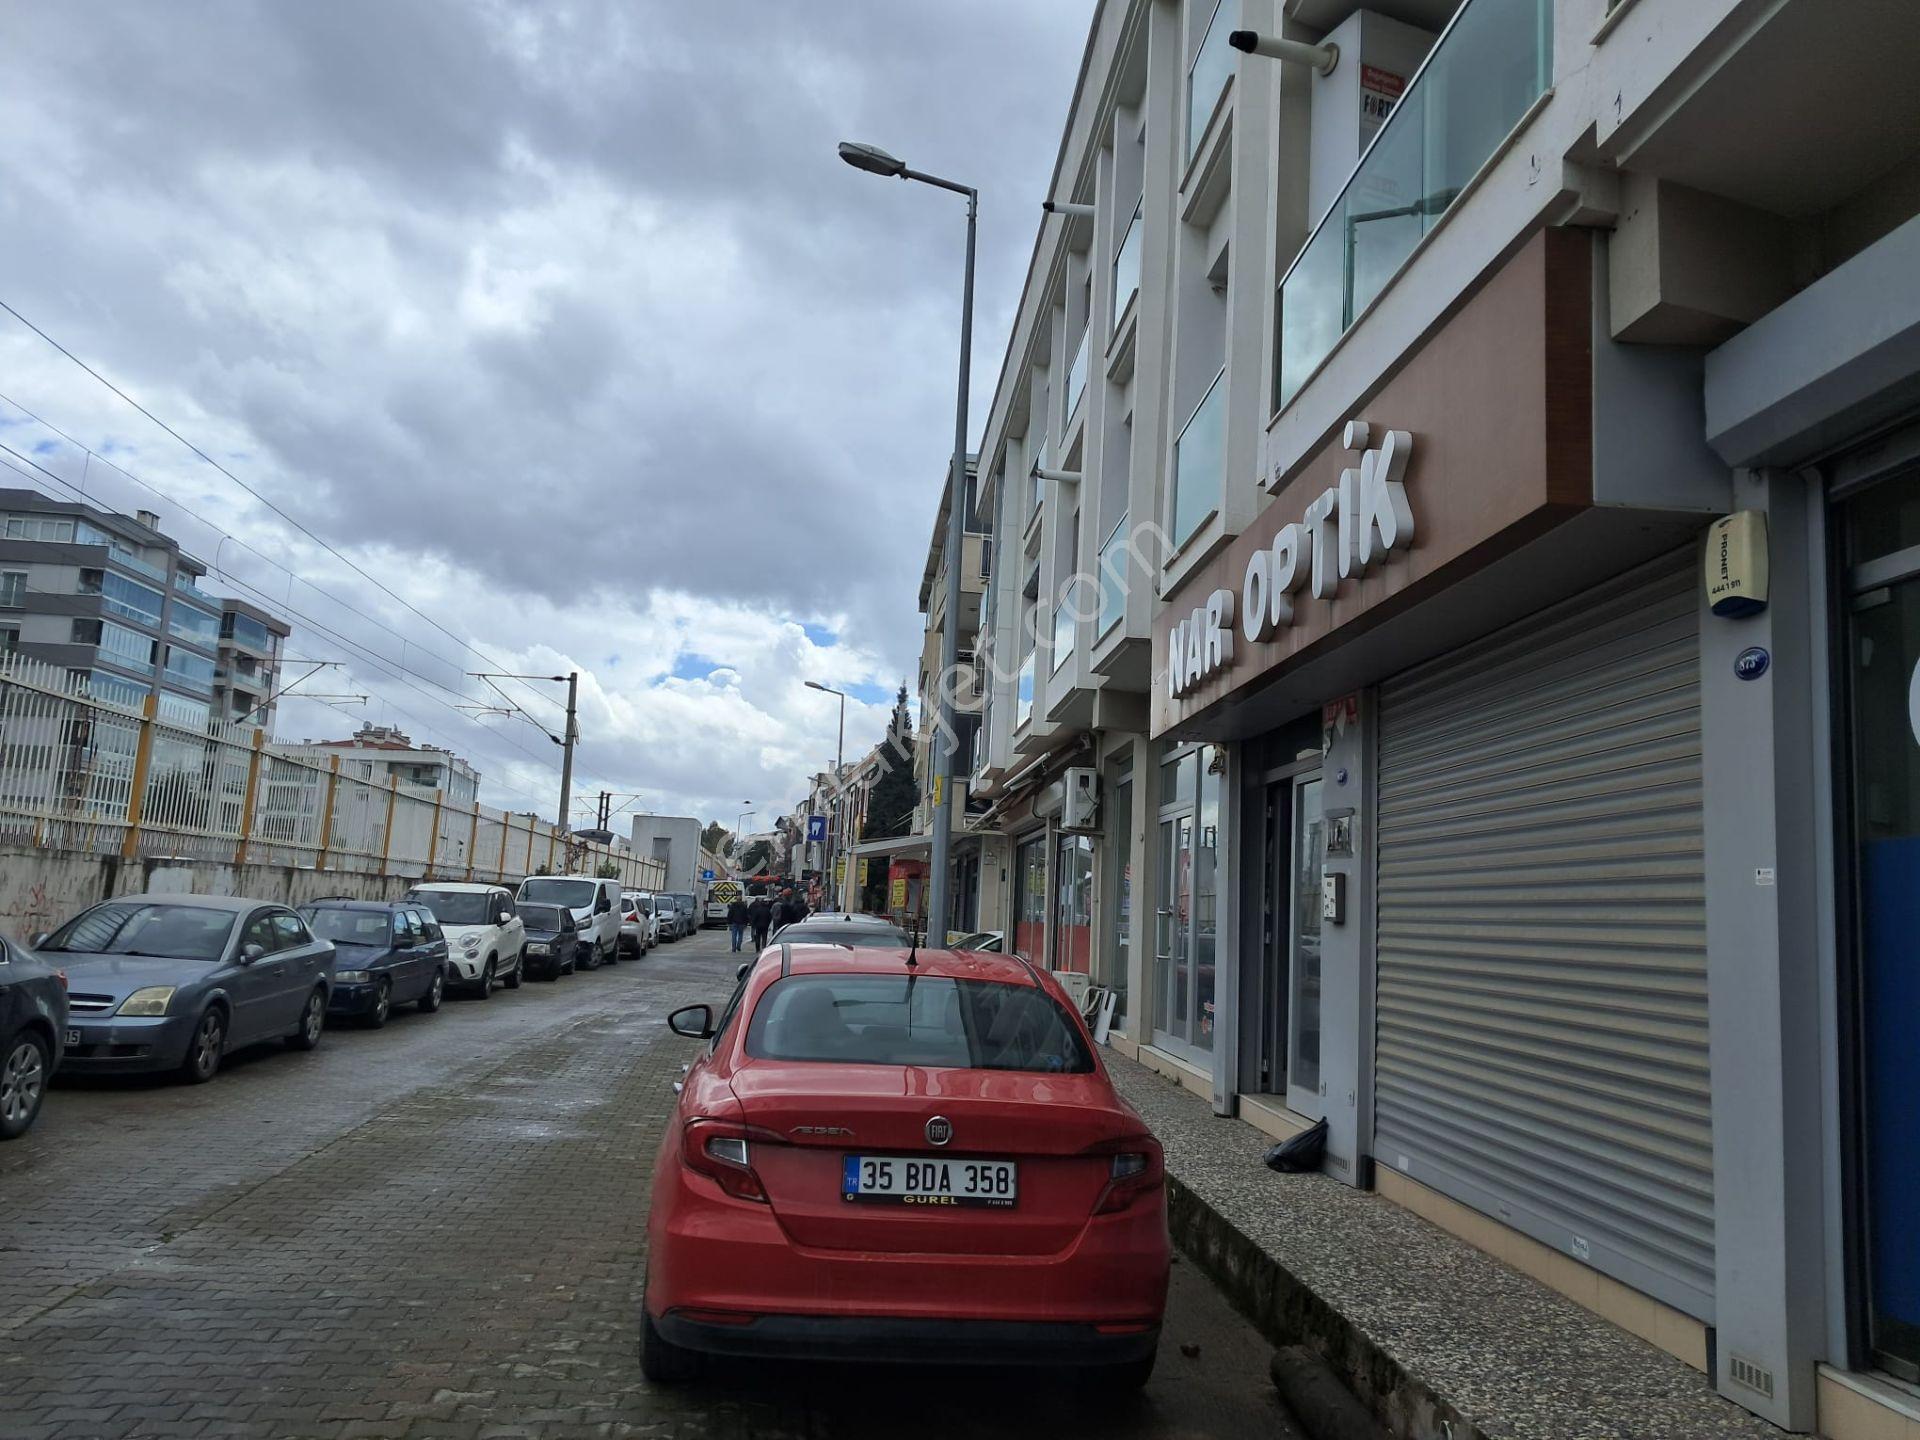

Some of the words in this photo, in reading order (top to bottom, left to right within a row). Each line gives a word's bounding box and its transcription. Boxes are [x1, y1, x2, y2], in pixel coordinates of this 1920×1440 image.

[1712, 584, 1725, 594] 444
[1168, 589, 1235, 699] NAR
[931, 1125, 947, 1138] FIAT
[847, 1177, 858, 1186] TR
[862, 1161, 893, 1190] 35
[906, 1163, 951, 1192] BDA
[964, 1166, 1010, 1195] 358
